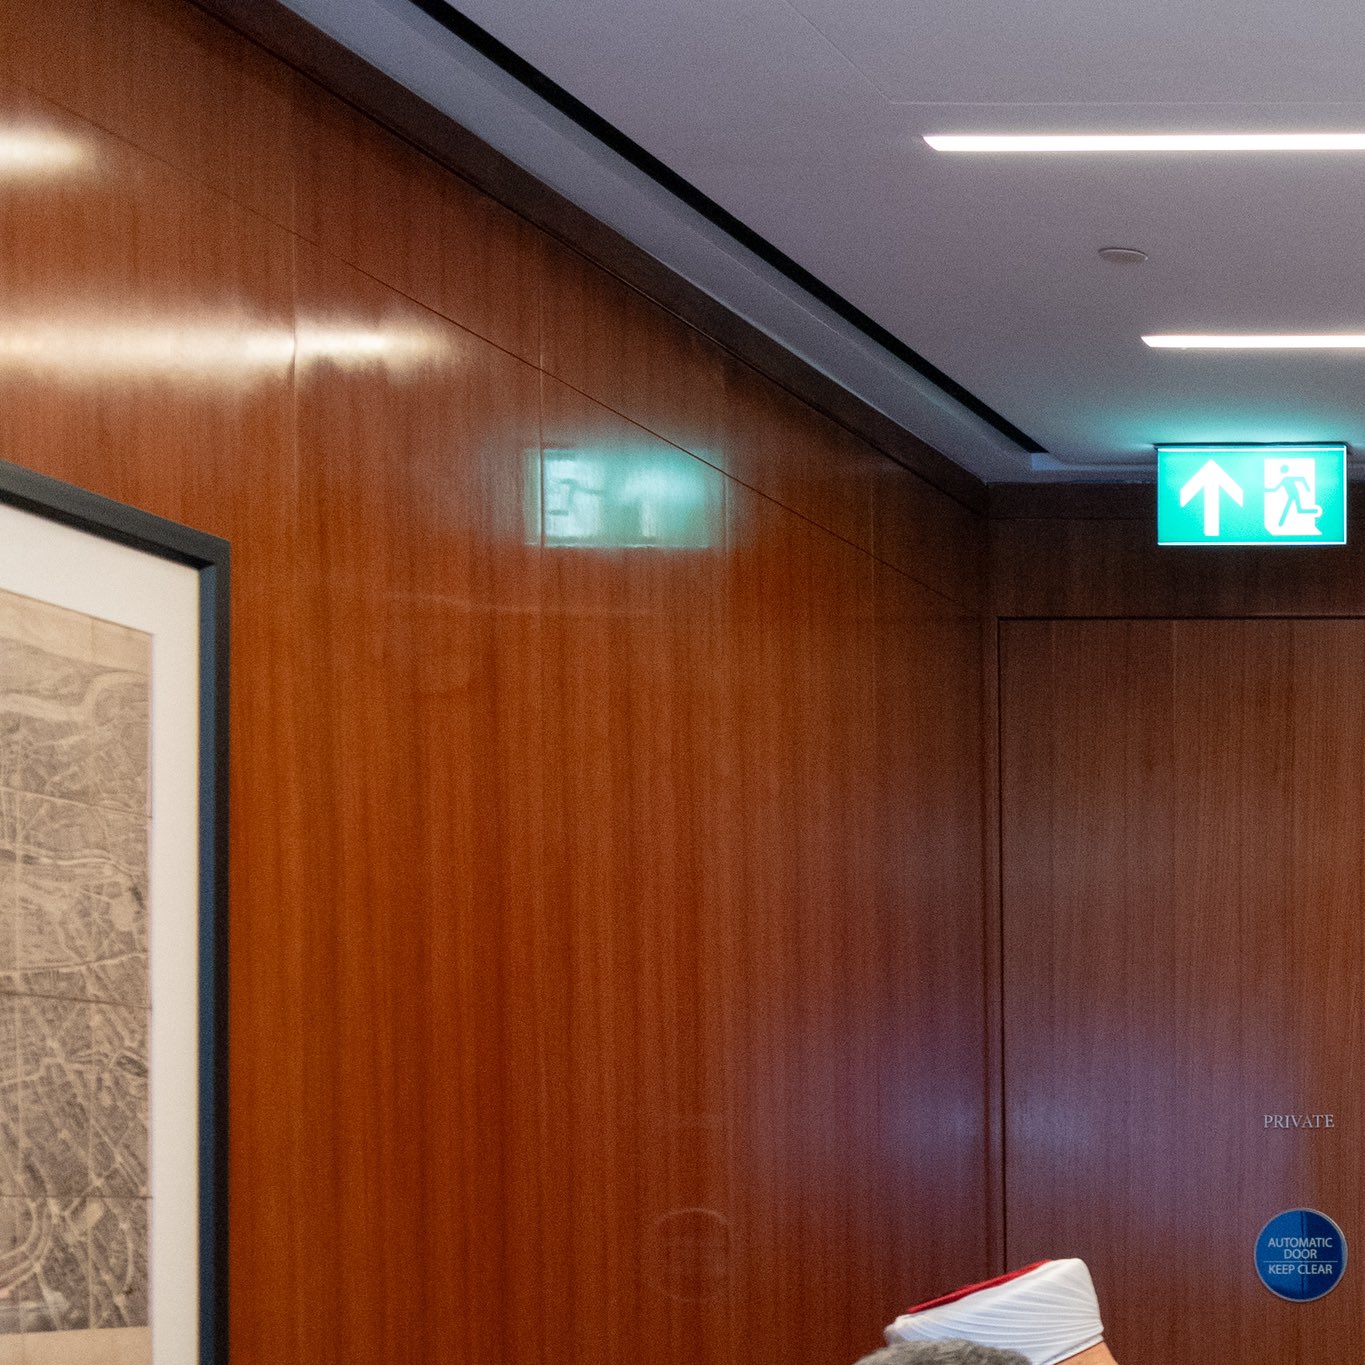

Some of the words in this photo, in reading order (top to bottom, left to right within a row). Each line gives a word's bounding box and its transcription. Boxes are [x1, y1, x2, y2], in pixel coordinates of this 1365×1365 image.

[1264, 1114, 1335, 1128] PRIVATE
[1267, 1237, 1333, 1248] AUTOMATIC
[1283, 1249, 1318, 1259] DOOR
[1268, 1264, 1295, 1275] KEEP
[1297, 1264, 1333, 1275] CLEAR
